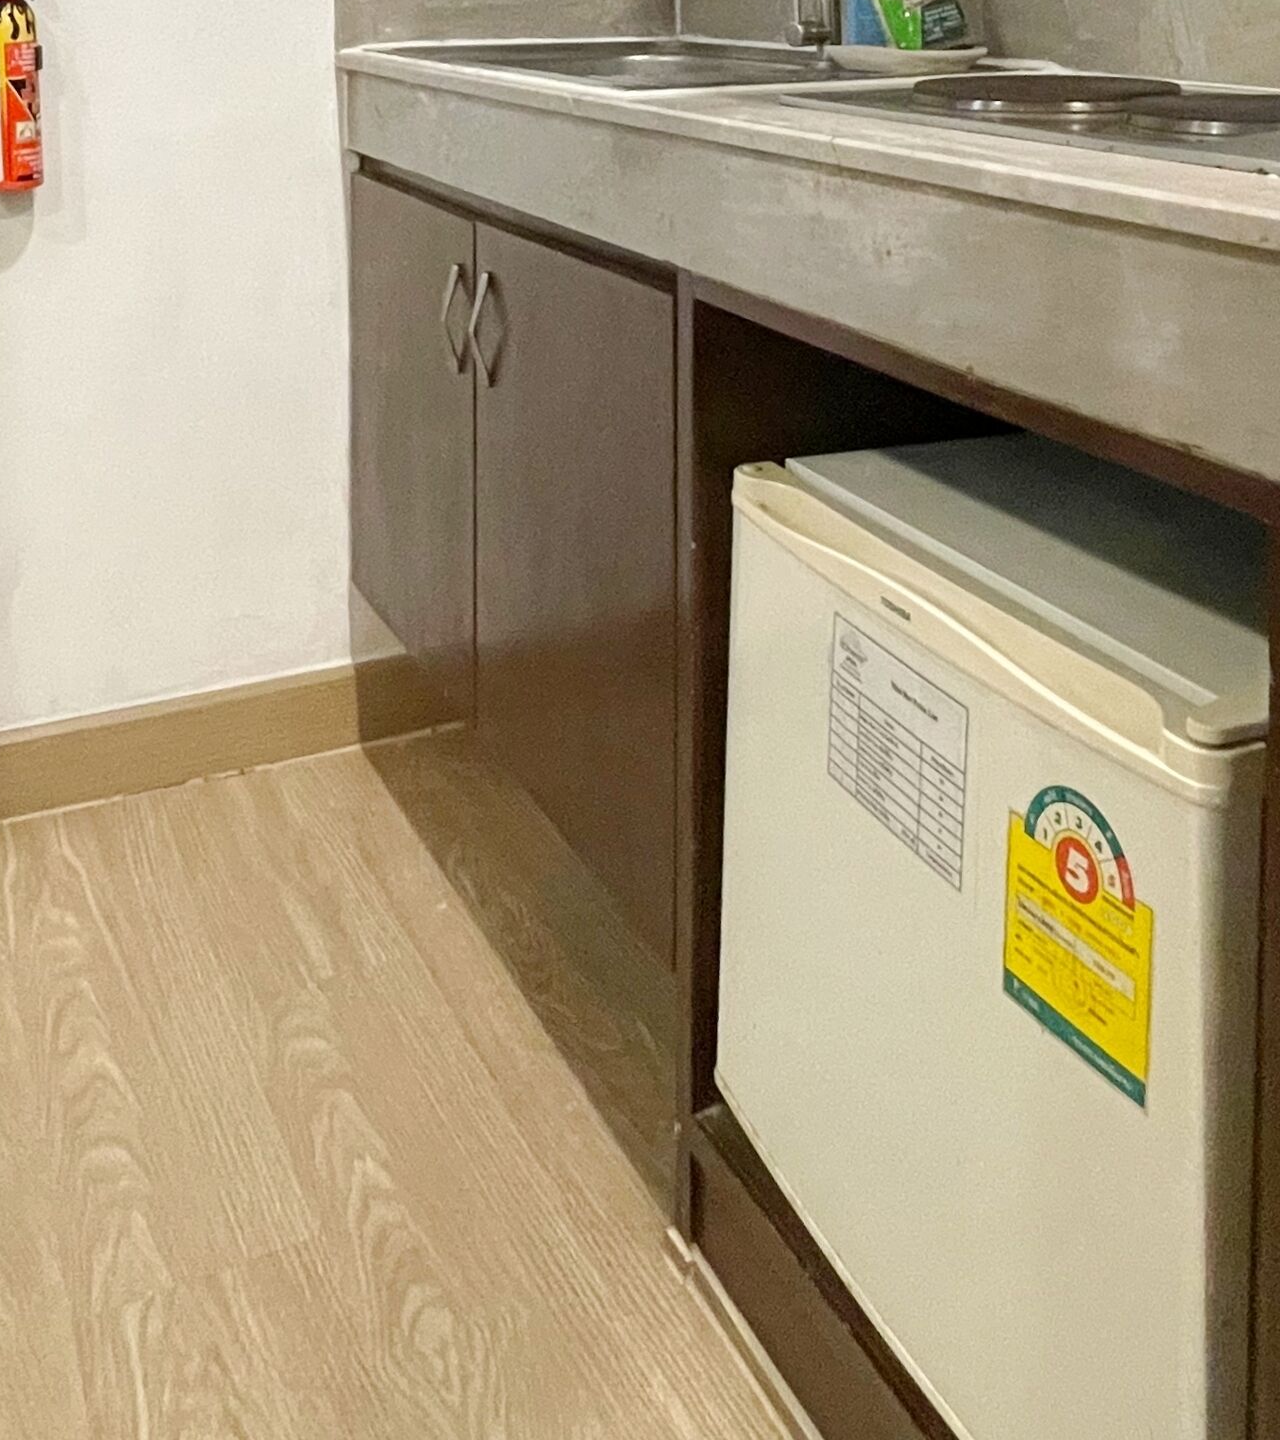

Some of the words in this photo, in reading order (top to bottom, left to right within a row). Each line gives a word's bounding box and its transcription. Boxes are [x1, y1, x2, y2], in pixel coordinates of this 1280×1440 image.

[1054, 811, 1062, 826] 2
[1075, 815, 1084, 830] 3
[1064, 846, 1090, 894] 5
